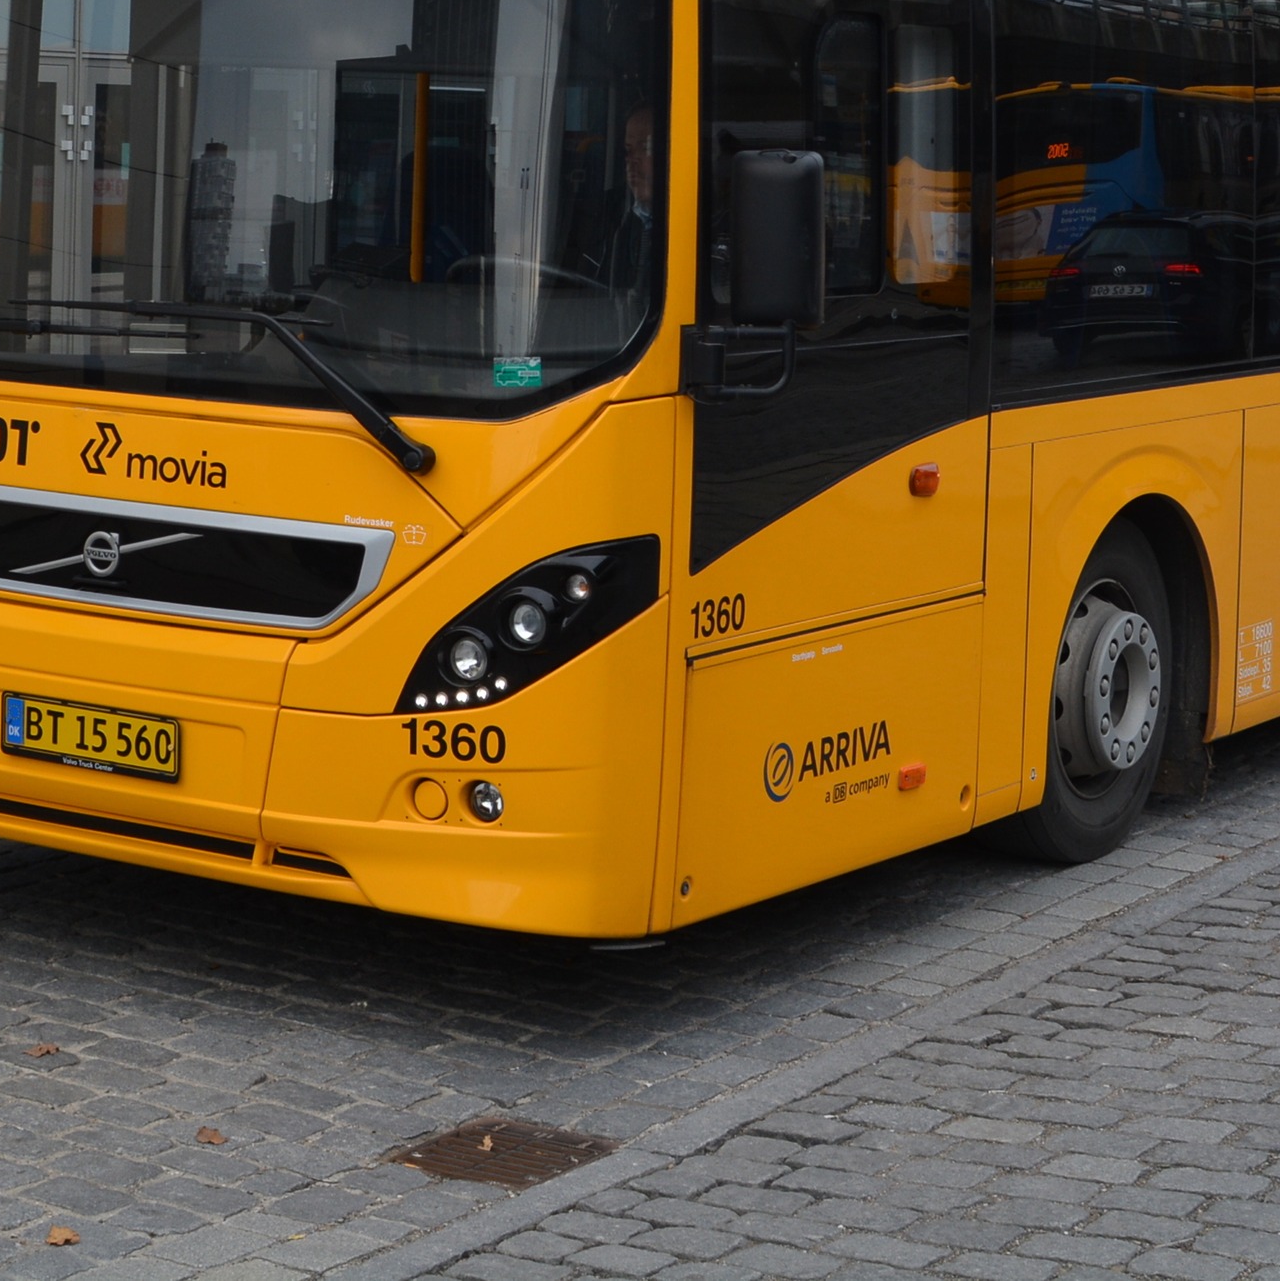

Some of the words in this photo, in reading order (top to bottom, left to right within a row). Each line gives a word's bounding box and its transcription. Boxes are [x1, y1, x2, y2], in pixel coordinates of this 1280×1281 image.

[126, 450, 227, 489] movia
[344, 514, 394, 528] Rudevasker
[86, 549, 117, 559] VOLVO
[691, 592, 746, 639] 1360
[8, 724, 20, 737] DK
[26, 706, 64, 745] BT
[75, 715, 107, 753] 15
[116, 721, 172, 766] 560
[401, 717, 506, 764] 1360
[798, 720, 891, 782] ARRIVA
[62, 756, 77, 767] Volvo
[78, 759, 94, 769] Truck
[94, 762, 113, 772] Center
[824, 791, 831, 803] a
[833, 783, 846, 801] DB
[848, 772, 890, 796] company
